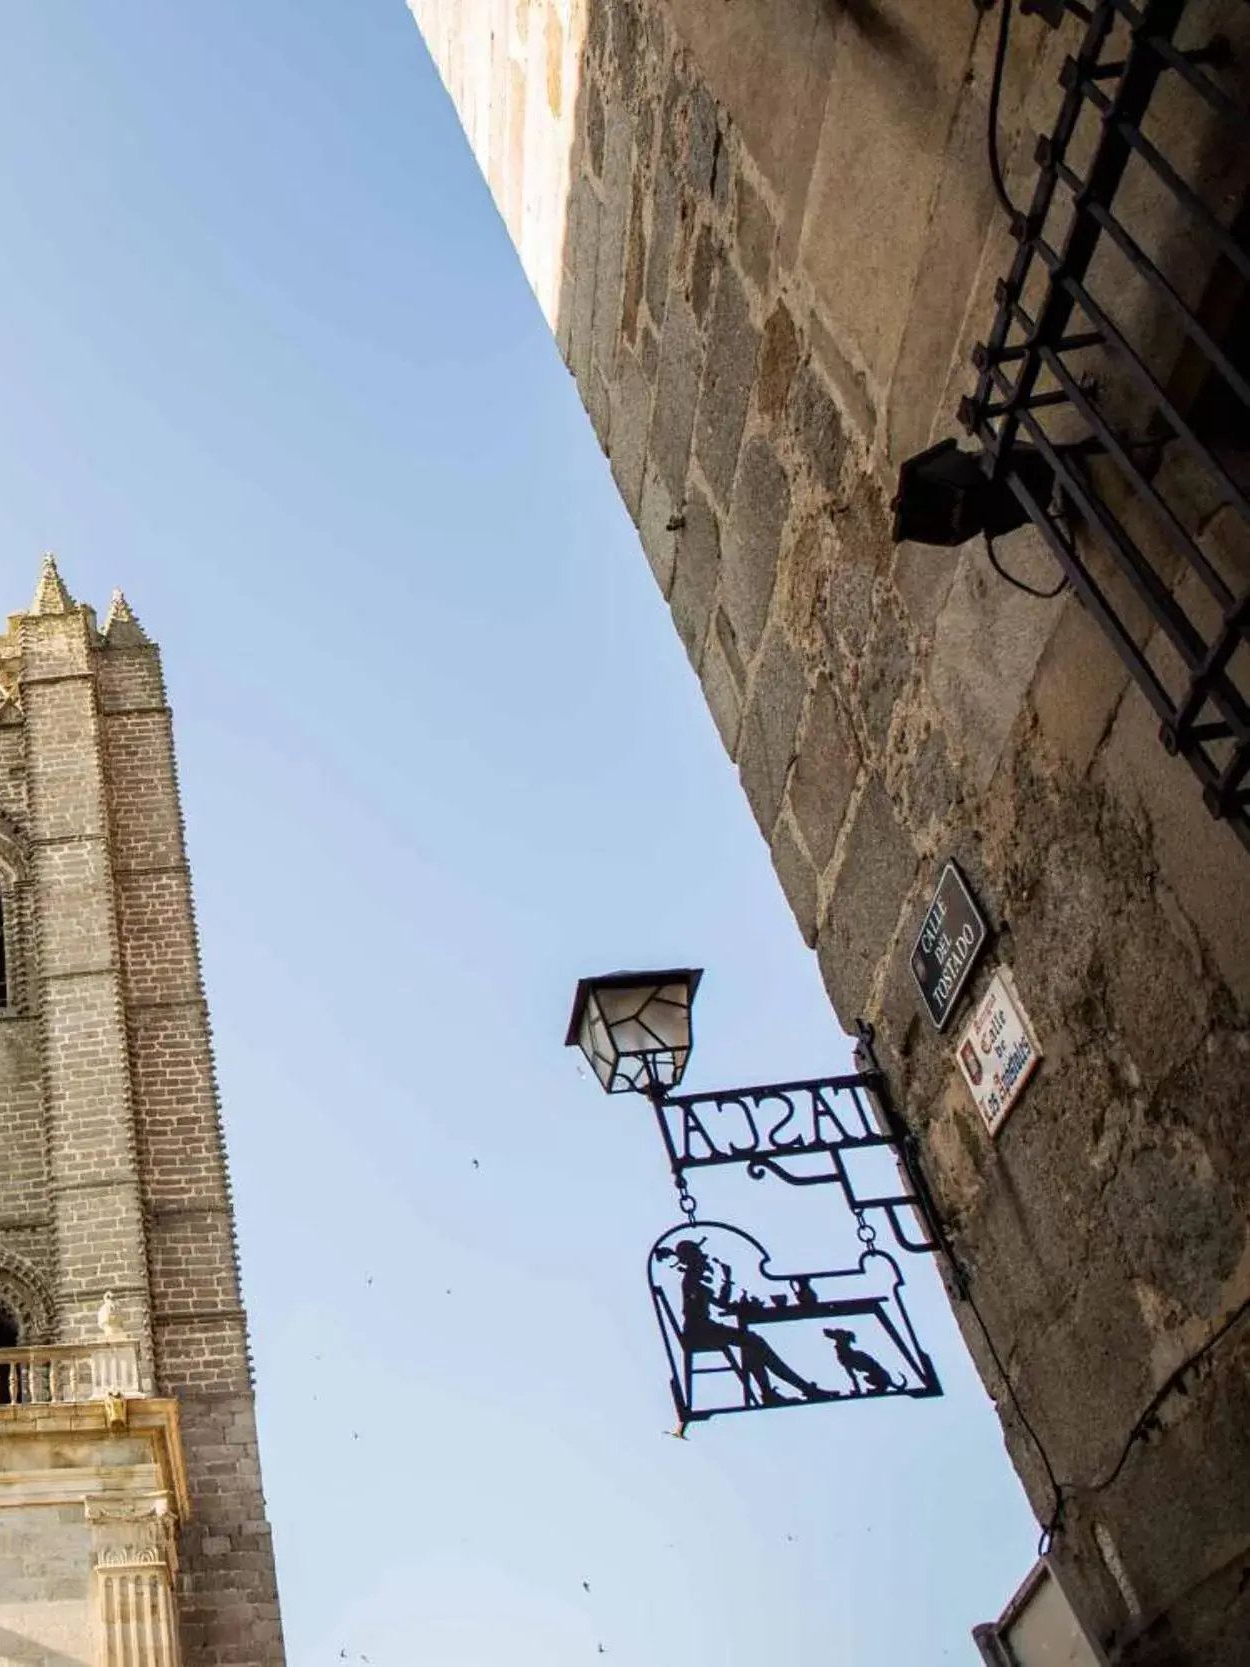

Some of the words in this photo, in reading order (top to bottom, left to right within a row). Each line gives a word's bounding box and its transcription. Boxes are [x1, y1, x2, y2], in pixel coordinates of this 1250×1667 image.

[921, 898, 947, 953] CALLE
[935, 932, 952, 965] DEL
[933, 923, 974, 1009] TOSTADO
[981, 1010, 1007, 1054] Calle
